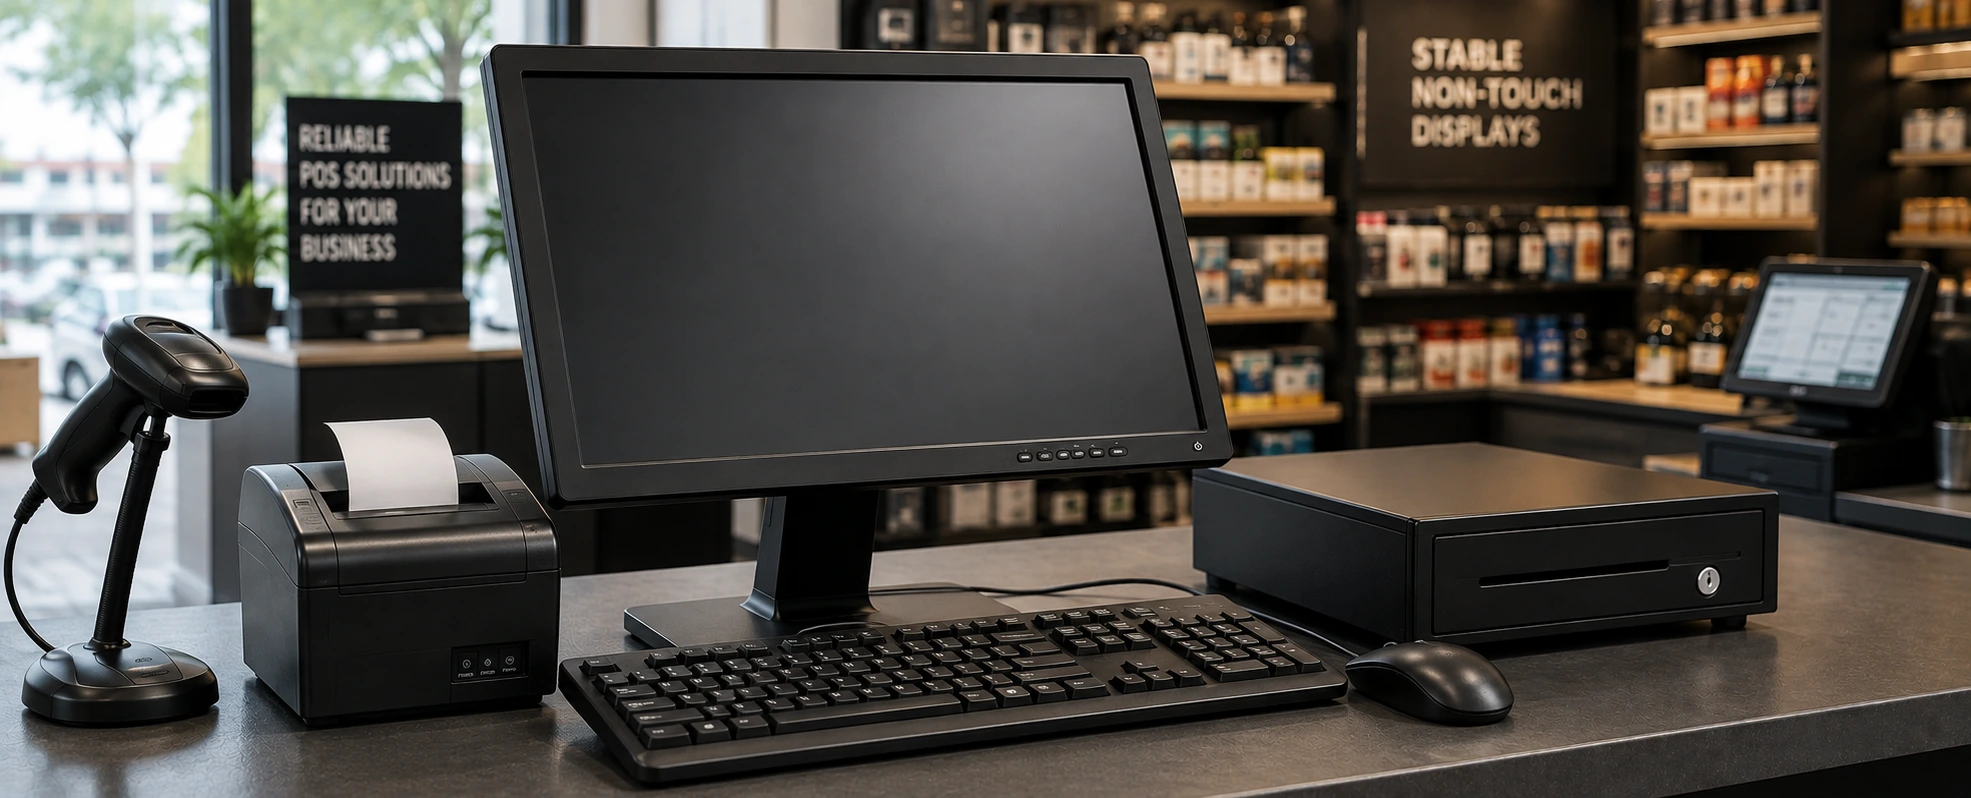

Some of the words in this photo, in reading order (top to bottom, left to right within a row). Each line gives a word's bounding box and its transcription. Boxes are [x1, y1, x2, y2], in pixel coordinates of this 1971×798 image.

[1411, 37, 1523, 71] STABLE
[1411, 75, 1583, 110] NON-TOUCH
[298, 124, 391, 153] RELIABLE
[1411, 113, 1541, 148] DISPLAYS
[299, 161, 341, 189] POS
[343, 161, 452, 190] SOLUTIONS
[299, 197, 341, 226] FOR
[343, 197, 398, 226] YOUR
[299, 233, 397, 262] BUSINESS
